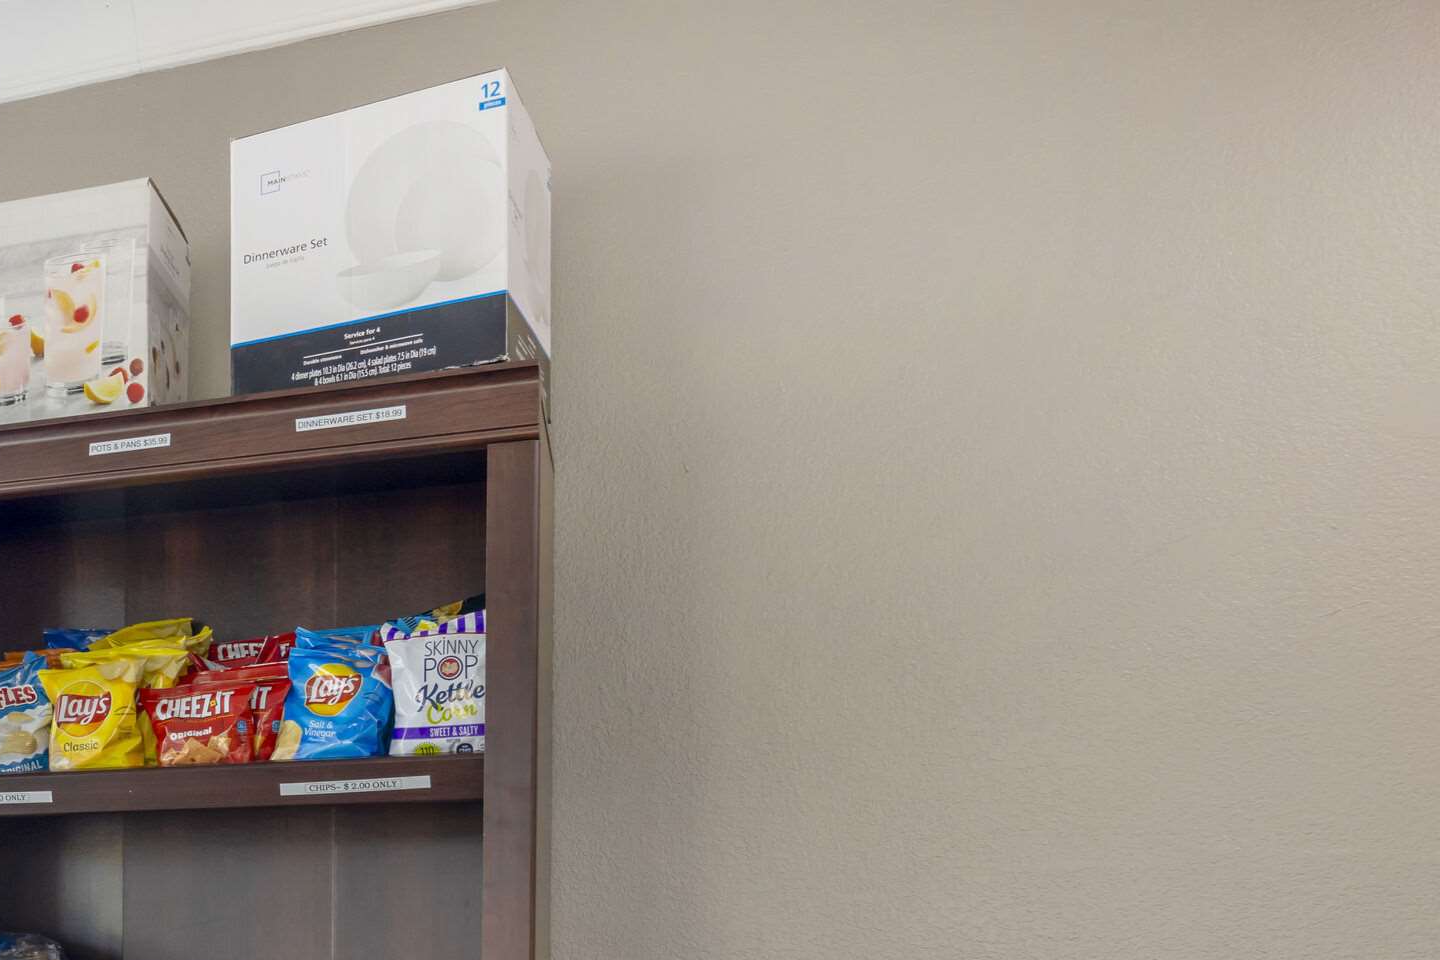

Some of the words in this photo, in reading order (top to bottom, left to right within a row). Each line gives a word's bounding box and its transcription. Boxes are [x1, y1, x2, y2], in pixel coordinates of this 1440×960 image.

[481, 81, 501, 98] 12
[243, 241, 307, 265] Dinnerware
[310, 237, 328, 250] Set
[344, 329, 364, 340] Service
[365, 327, 375, 336] for
[297, 412, 355, 429] DINNERWARE
[357, 411, 373, 422] SET
[91, 444, 112, 453] POTS
[120, 440, 141, 449] PANS
[424, 637, 480, 657] SKINNY
[424, 655, 478, 682] POP
[309, 675, 359, 706] Lay's
[415, 679, 485, 712] Kettle
[60, 693, 110, 725] Lay's
[427, 703, 478, 725] Corn
[304, 727, 337, 738] Vinegar
[308, 720, 325, 729] Salt
[326, 720, 334, 729] &
[429, 727, 451, 738] SWEET
[452, 727, 458, 737] &
[459, 725, 479, 736] SALTY
[63, 741, 99, 753] Classic
[351, 781, 371, 790] 2.00
[372, 780, 397, 789] ONLY
[5, 793, 26, 802] ONLY
